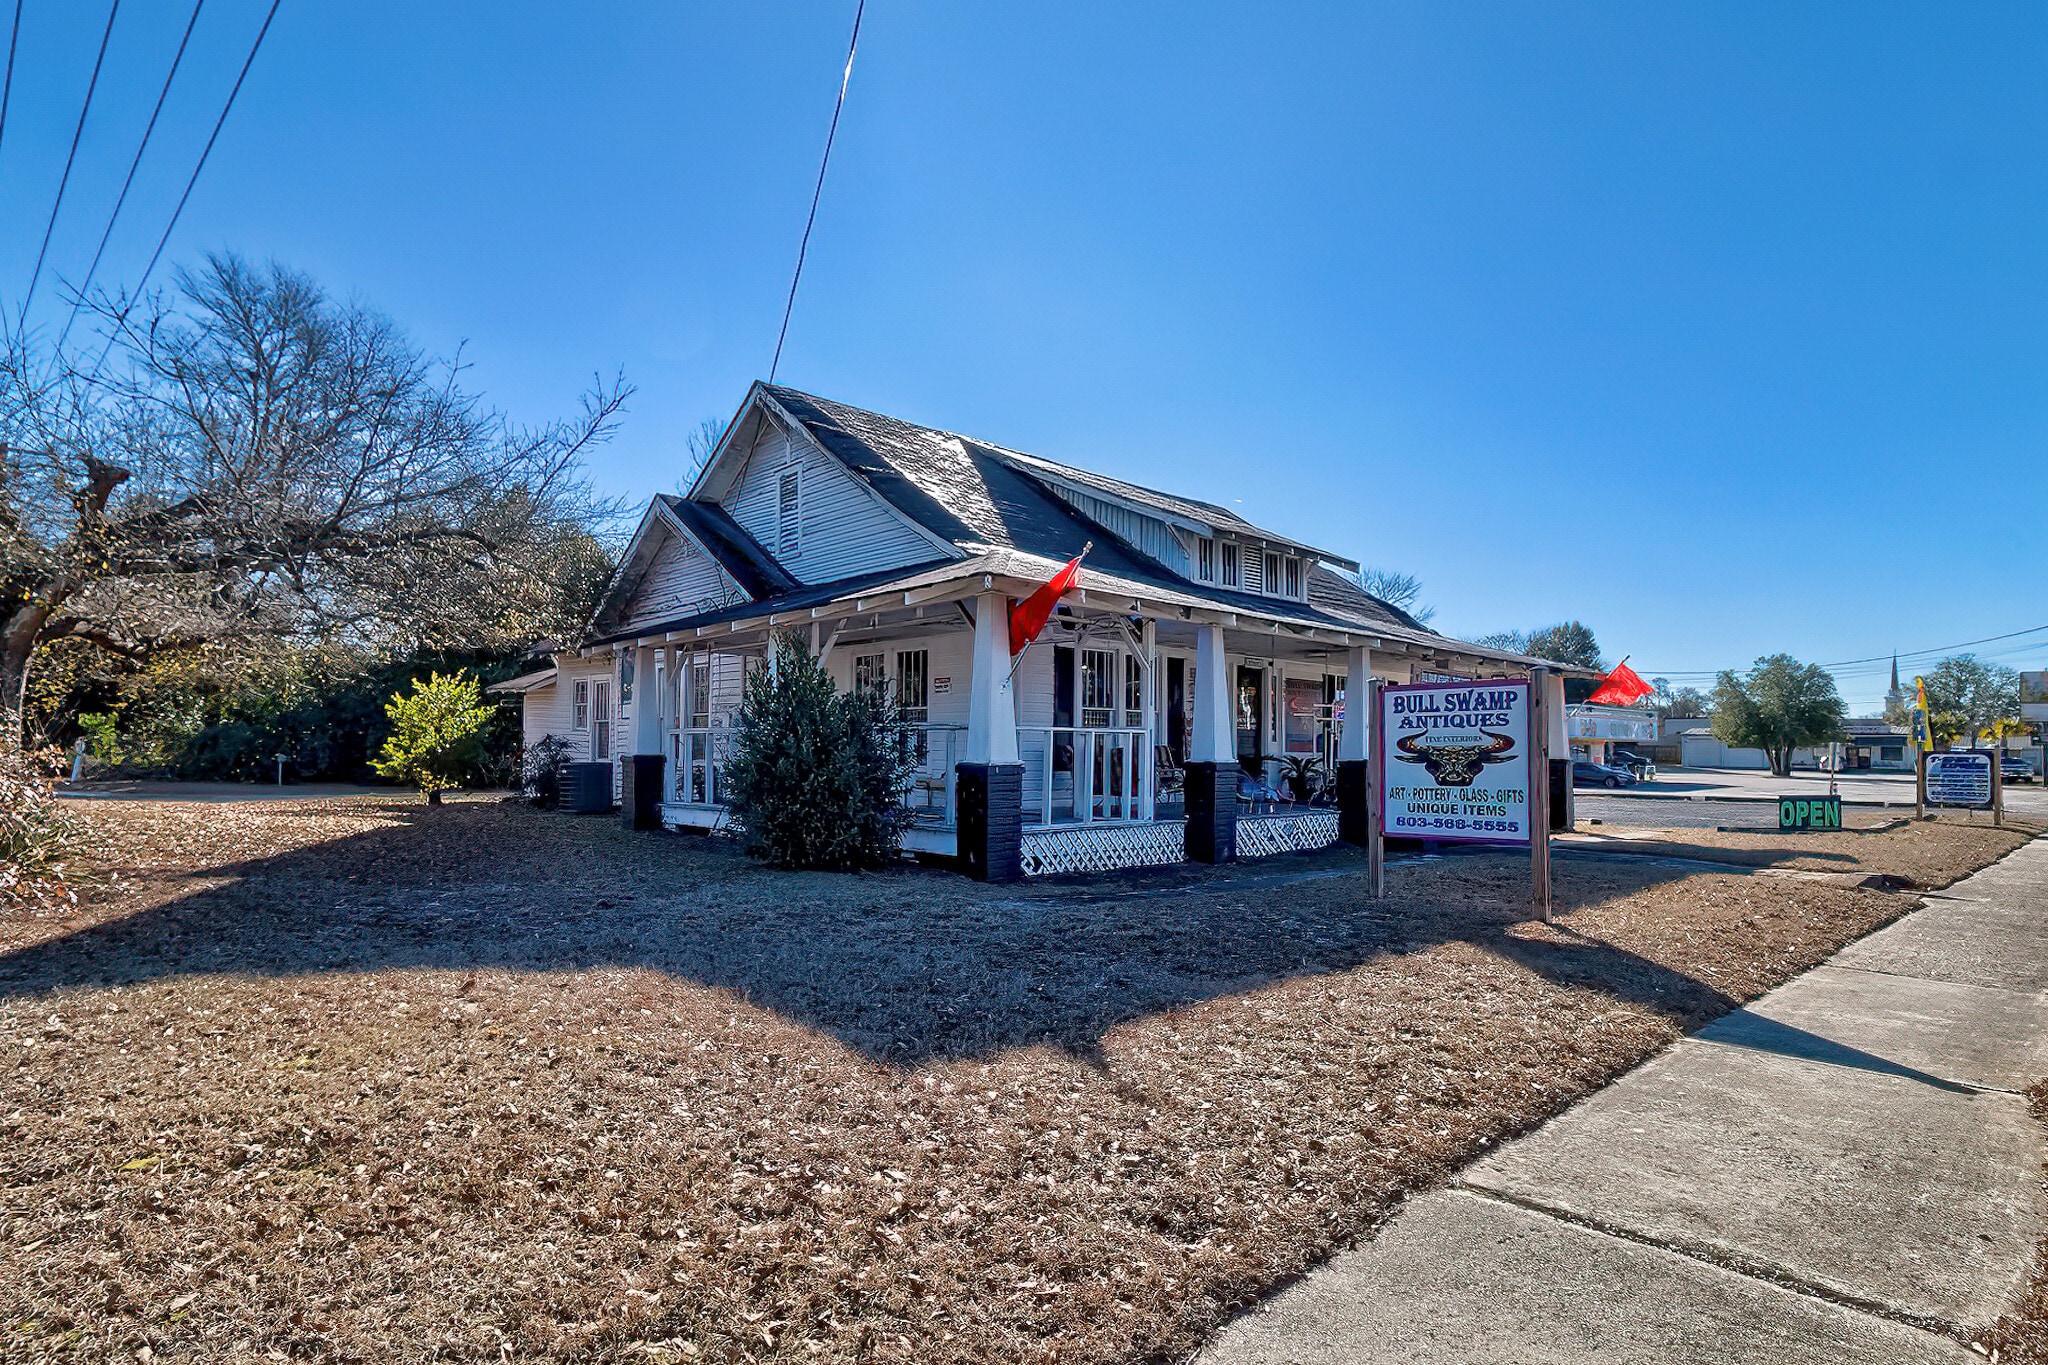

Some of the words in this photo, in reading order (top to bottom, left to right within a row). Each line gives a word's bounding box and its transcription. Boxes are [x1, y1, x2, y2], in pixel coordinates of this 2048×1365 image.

[1393, 694, 1439, 714] BULL
[1444, 689, 1518, 712] SWAMP
[1398, 713, 1509, 729] ANTIQUES
[1425, 735, 1442, 743] FINE
[1443, 735, 1483, 743] INTERIORS
[1389, 787, 1406, 800] ART
[1413, 787, 1452, 801] POTTERY
[1459, 788, 1489, 803] GLASS
[1496, 789, 1525, 804] GIFTS
[1407, 802, 1459, 815] UNIQUE
[1463, 804, 1507, 817] ITEMS
[1781, 801, 1839, 826] OPEN
